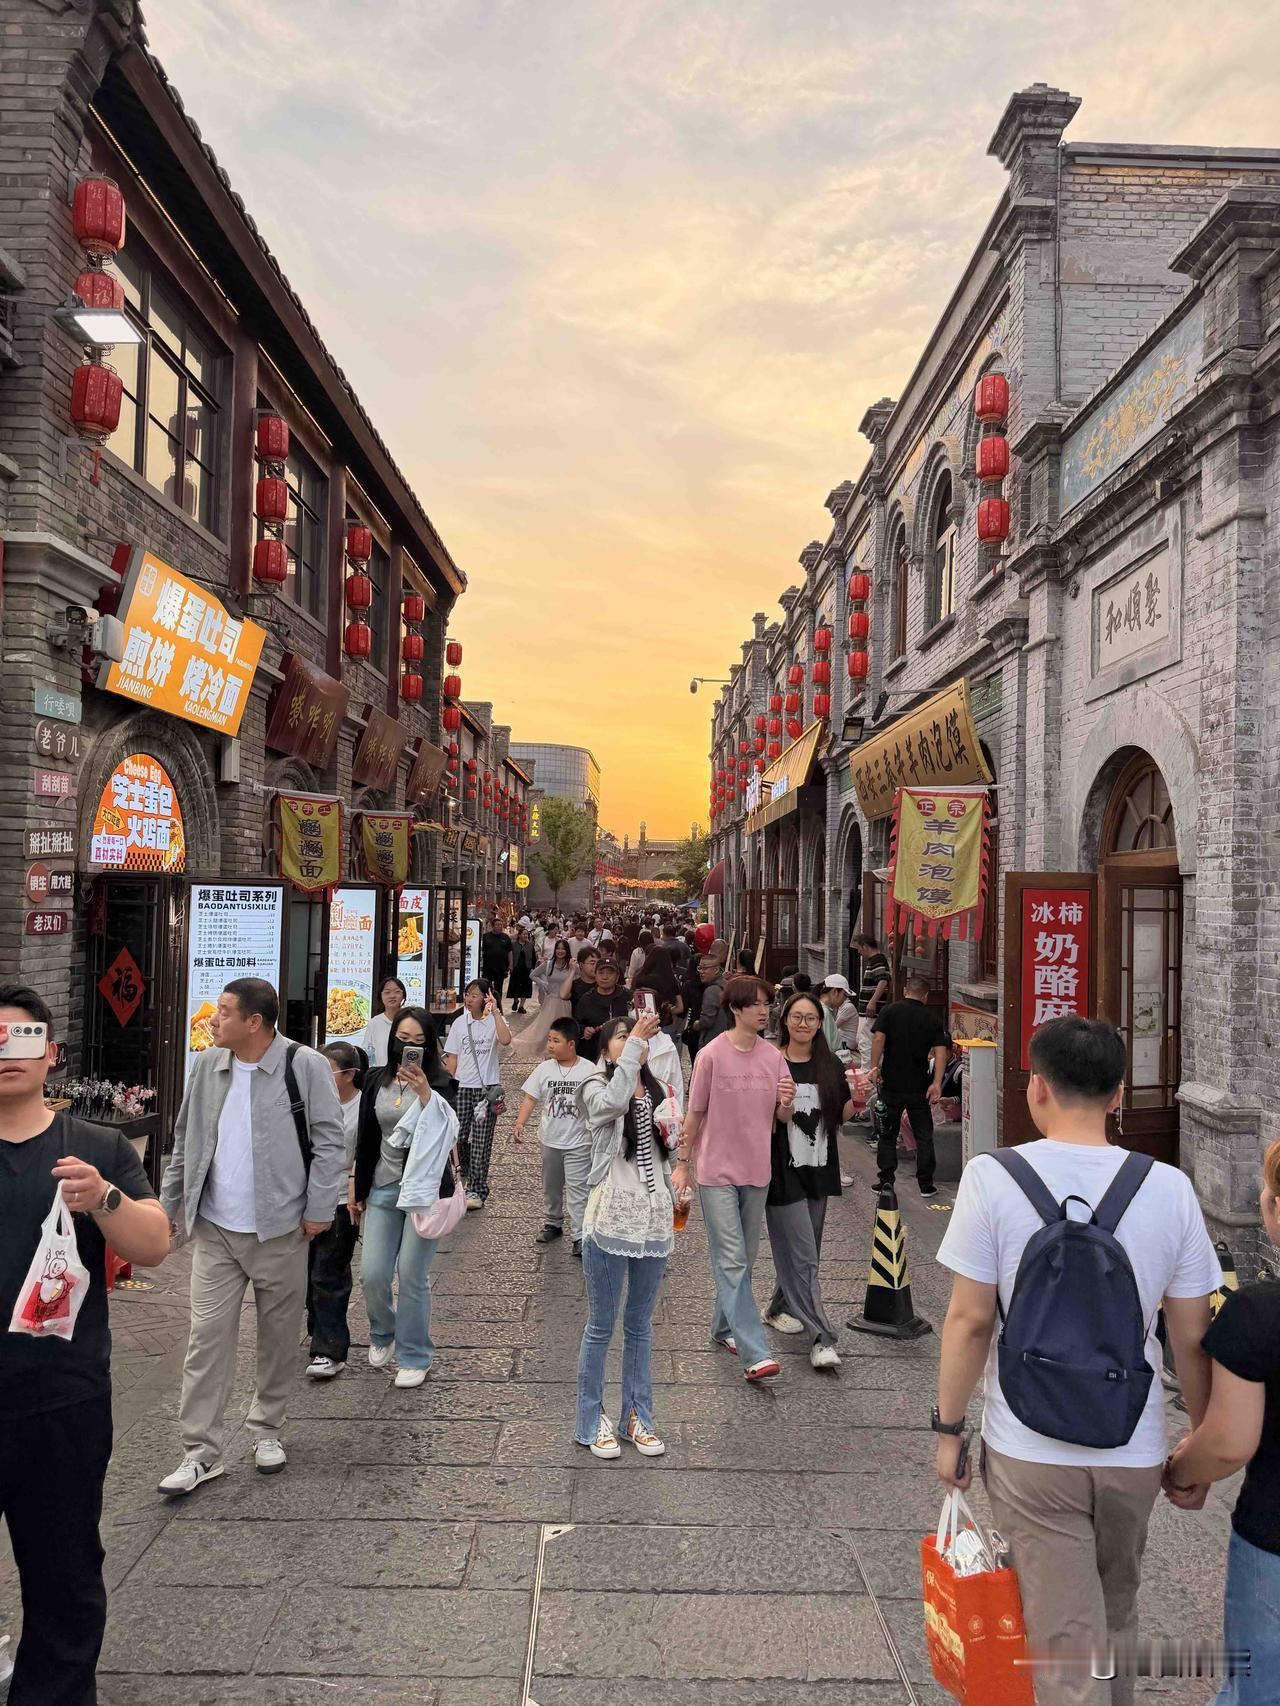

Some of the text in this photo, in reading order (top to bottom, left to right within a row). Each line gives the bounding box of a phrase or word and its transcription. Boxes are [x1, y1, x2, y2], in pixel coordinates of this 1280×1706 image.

[152, 577, 243, 663] 爆蛋吐司
[119, 626, 243, 717] 煎饼 烤冷面
[116, 675, 153, 699] JIANBING
[184, 701, 227, 726] KAOLENGMIAN
[40, 727, 79, 757] 老爷儿
[112, 773, 172, 816] 芝士蛋包
[919, 800, 965, 816] 正宗
[30, 831, 73, 854] 掰扯掰扯
[127, 815, 170, 851] 火鸡面
[95, 847, 123, 862] 真材实料
[916, 819, 960, 905] 羊肉泡馍
[198, 889, 277, 903] 爆蛋吐司系列
[33, 914, 62, 932] 老汉们
[1031, 901, 1084, 926] 冰柿
[193, 957, 256, 968] 爆蛋吐司加料
[112, 966, 138, 1008] 福
